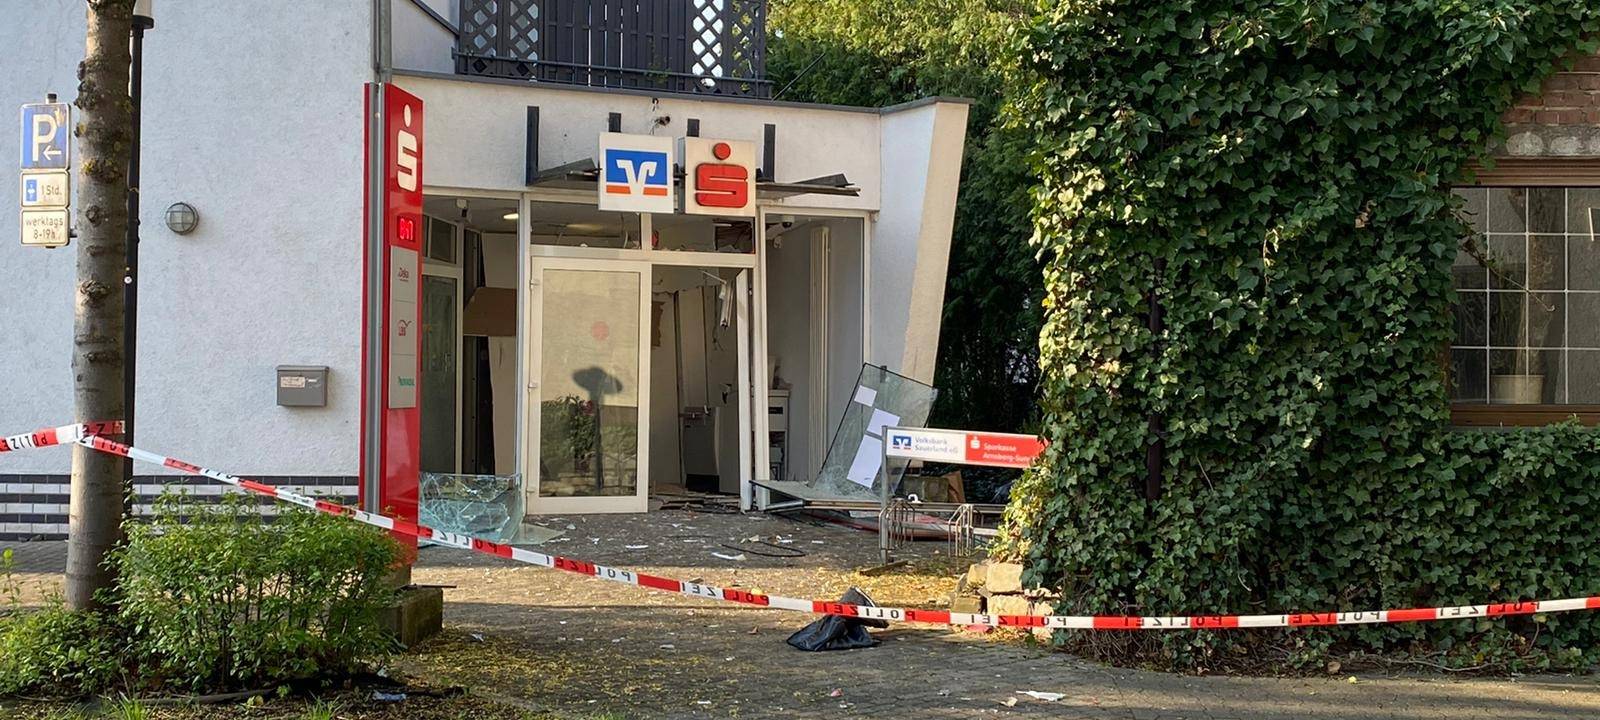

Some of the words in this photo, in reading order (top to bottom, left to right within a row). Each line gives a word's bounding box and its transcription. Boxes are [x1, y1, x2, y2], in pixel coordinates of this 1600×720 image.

[32, 114, 57, 162] P
[46, 185, 62, 195] Std.
[25, 216, 63, 229] werktags
[0, 433, 48, 452] POLIZE
[915, 437, 947, 445] Volksbank
[915, 445, 948, 453] Sauerland
[983, 443, 1016, 453] Sparkasse
